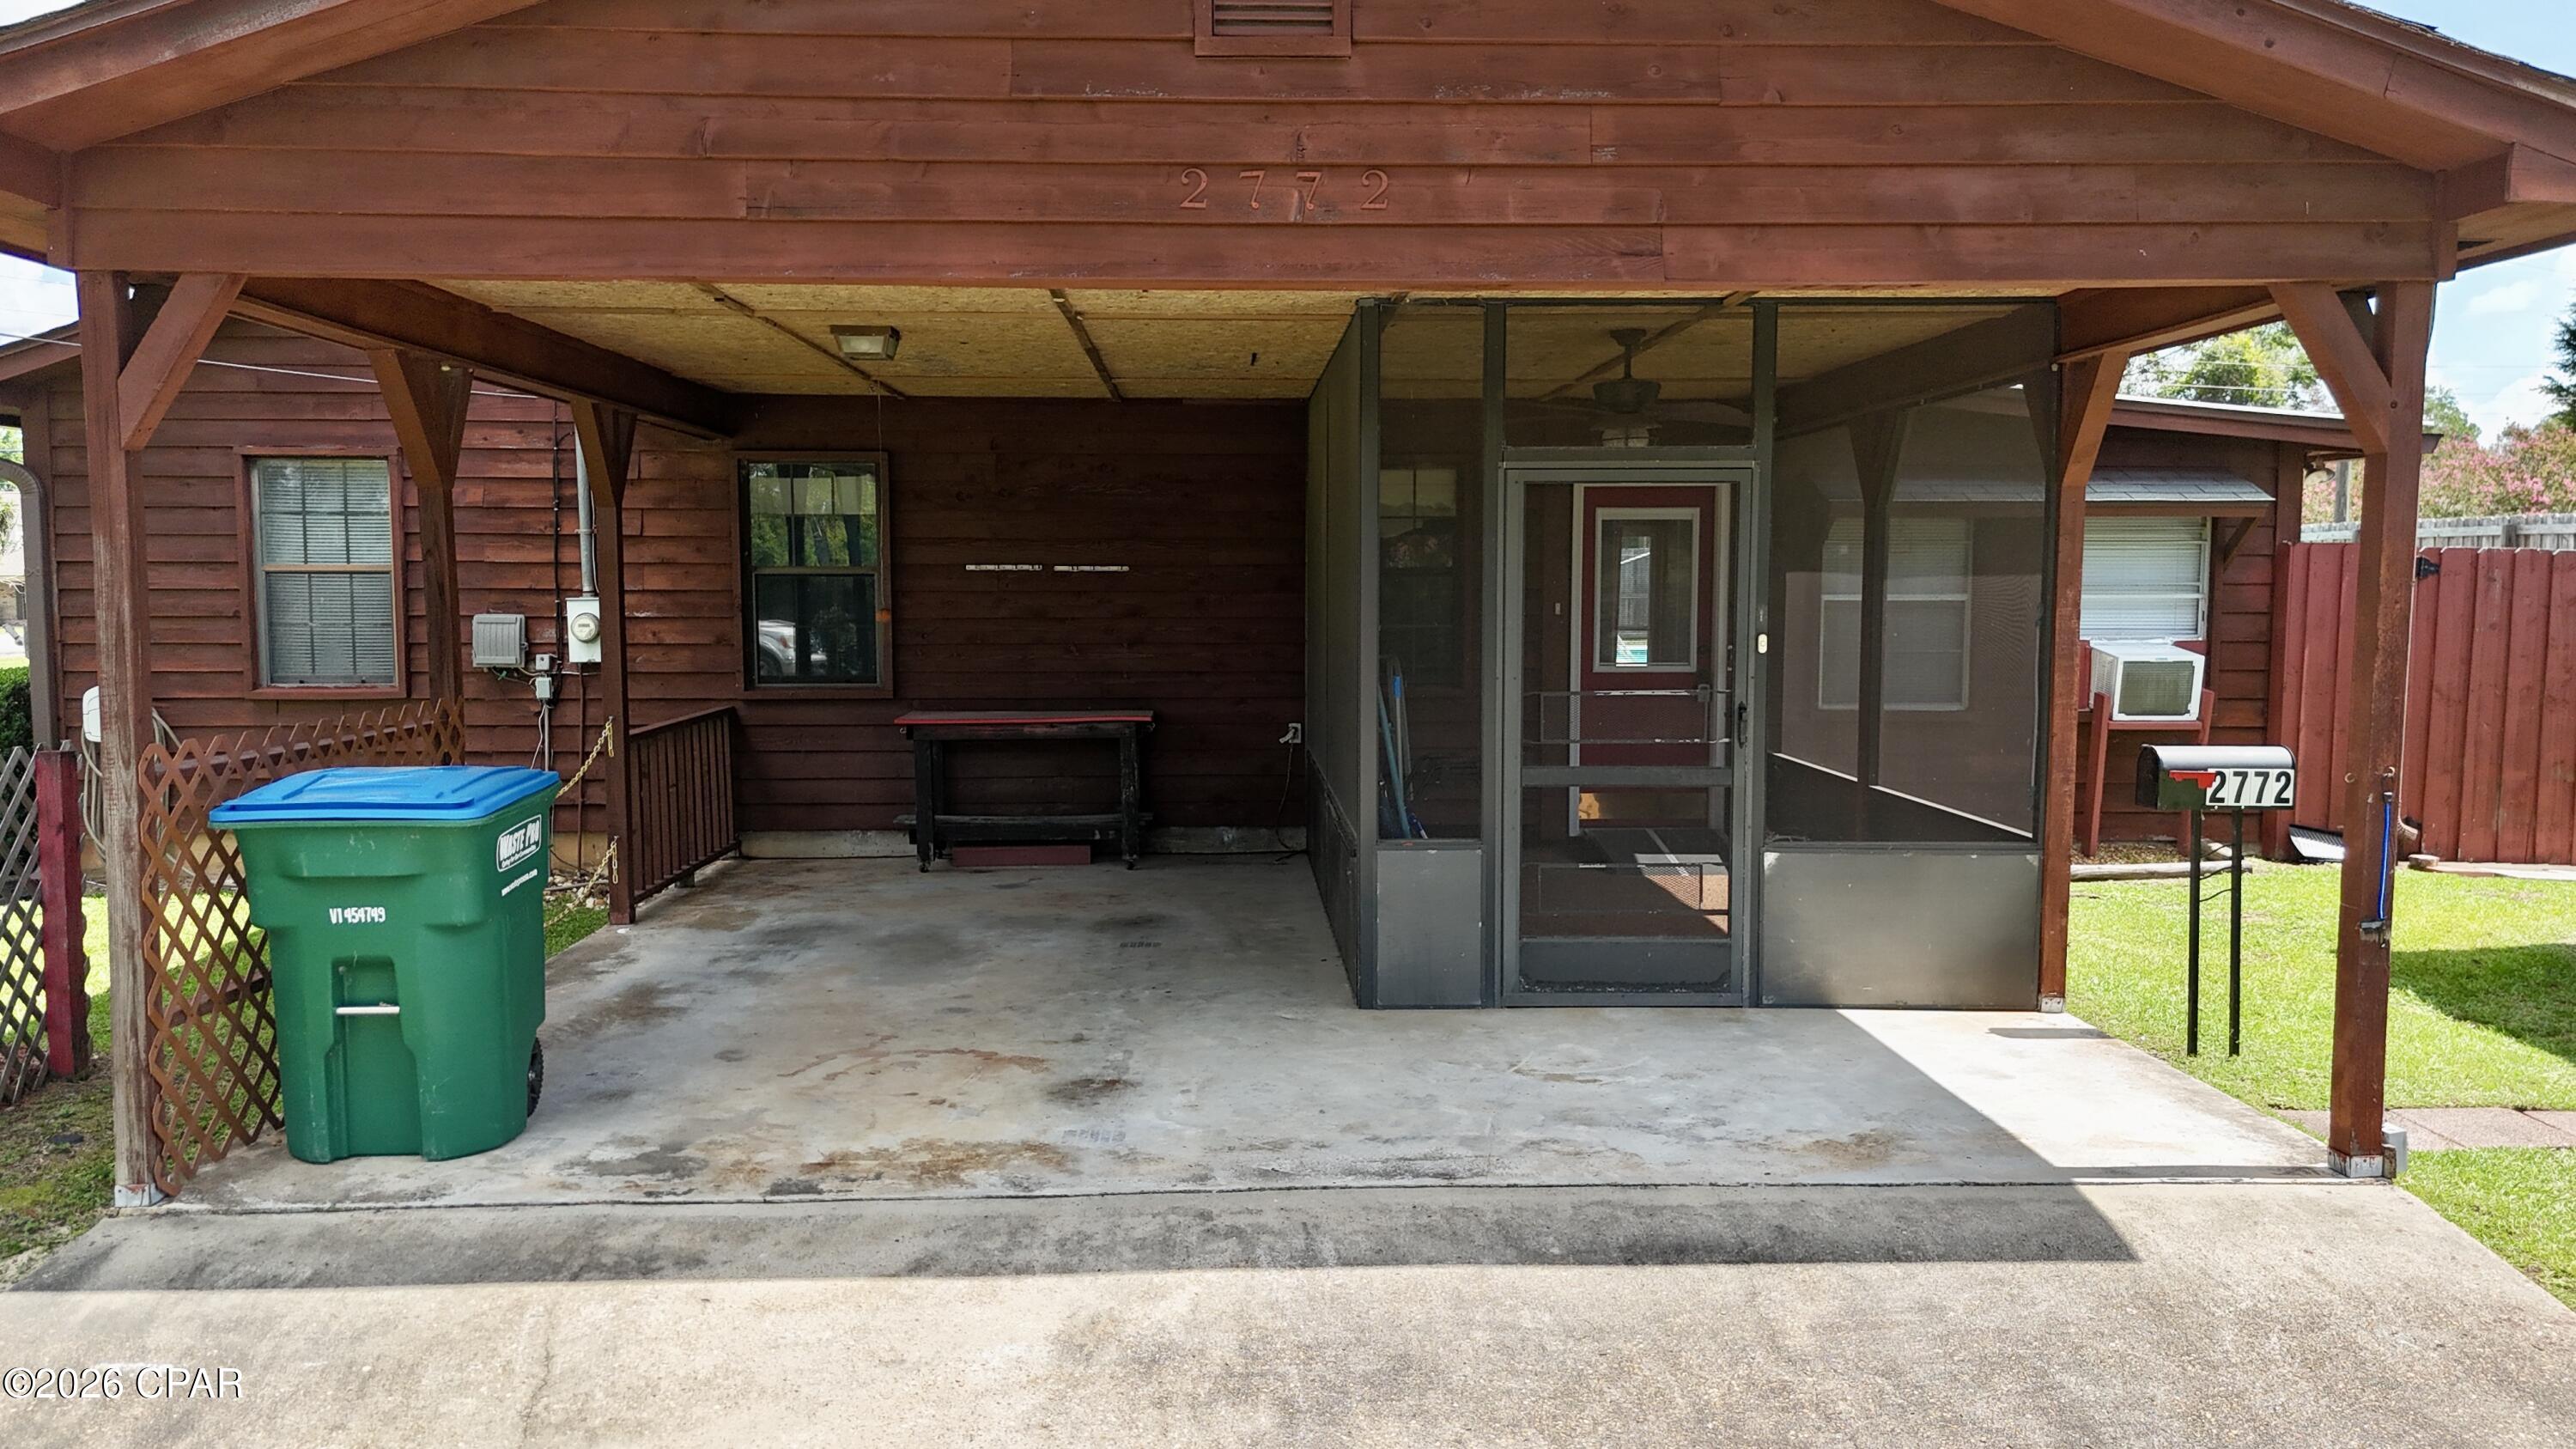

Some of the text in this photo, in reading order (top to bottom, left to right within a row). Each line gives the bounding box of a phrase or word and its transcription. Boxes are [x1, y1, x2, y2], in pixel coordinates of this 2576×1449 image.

[1180, 167, 1388, 210] 2772
[2208, 771, 2291, 804] 2772
[500, 828, 526, 861] WASTE
[343, 906, 386, 924] 454749
